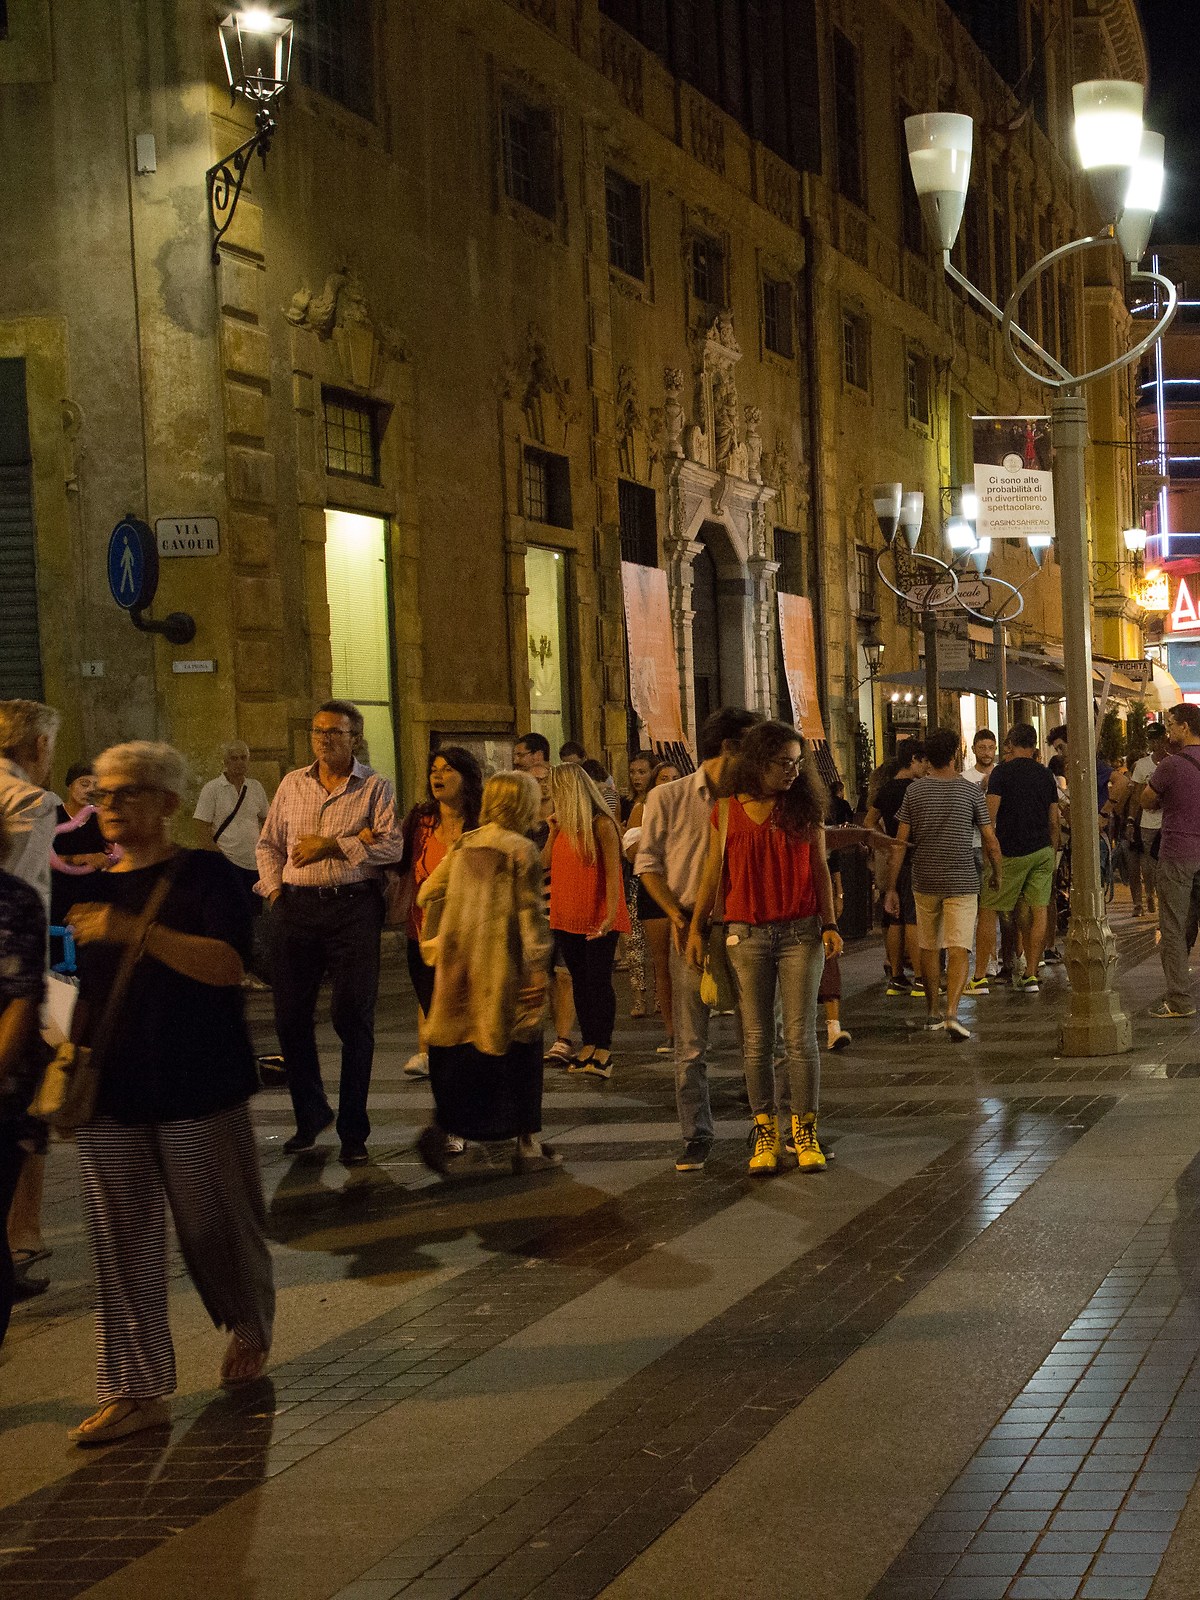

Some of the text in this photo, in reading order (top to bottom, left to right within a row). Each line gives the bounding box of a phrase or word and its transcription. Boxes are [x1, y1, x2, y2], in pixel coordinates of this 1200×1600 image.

[989, 476, 998, 484] Ci
[1024, 476, 1039, 484] alte
[987, 485, 1042, 494] probabilità di
[995, 494, 1048, 502] divertimento
[988, 504, 1043, 512] spettacolare.
[175, 524, 199, 535] VIA
[162, 538, 214, 551] CAVOUR
[90, 665, 96, 674] 2
[1114, 662, 1147, 670] TICHITA
